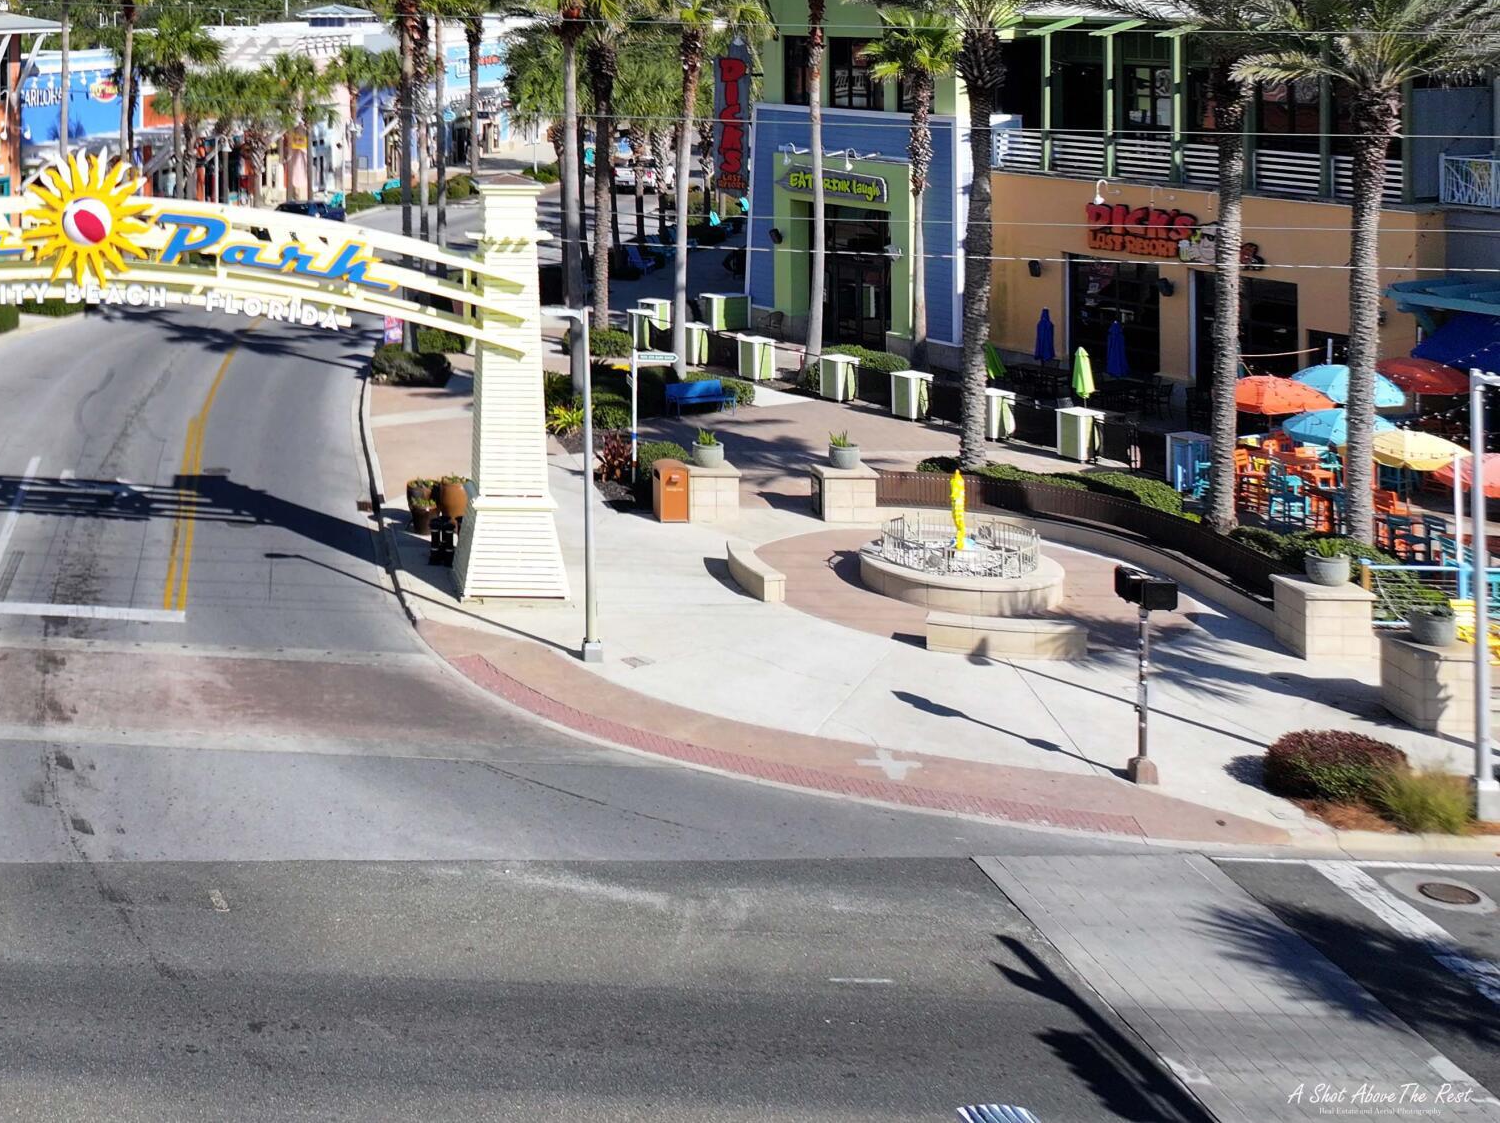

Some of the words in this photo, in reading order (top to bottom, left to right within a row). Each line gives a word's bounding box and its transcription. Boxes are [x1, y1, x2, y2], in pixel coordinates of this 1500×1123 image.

[789, 172, 813, 189] EAT
[821, 177, 851, 193] RINK
[1085, 203, 1199, 241] DICK'S
[150, 209, 399, 292] Park
[1088, 232, 1125, 251] LAST
[1125, 235, 1178, 258] RESORT
[64, 281, 167, 308] BEACH
[205, 291, 340, 331] FLORIDA
